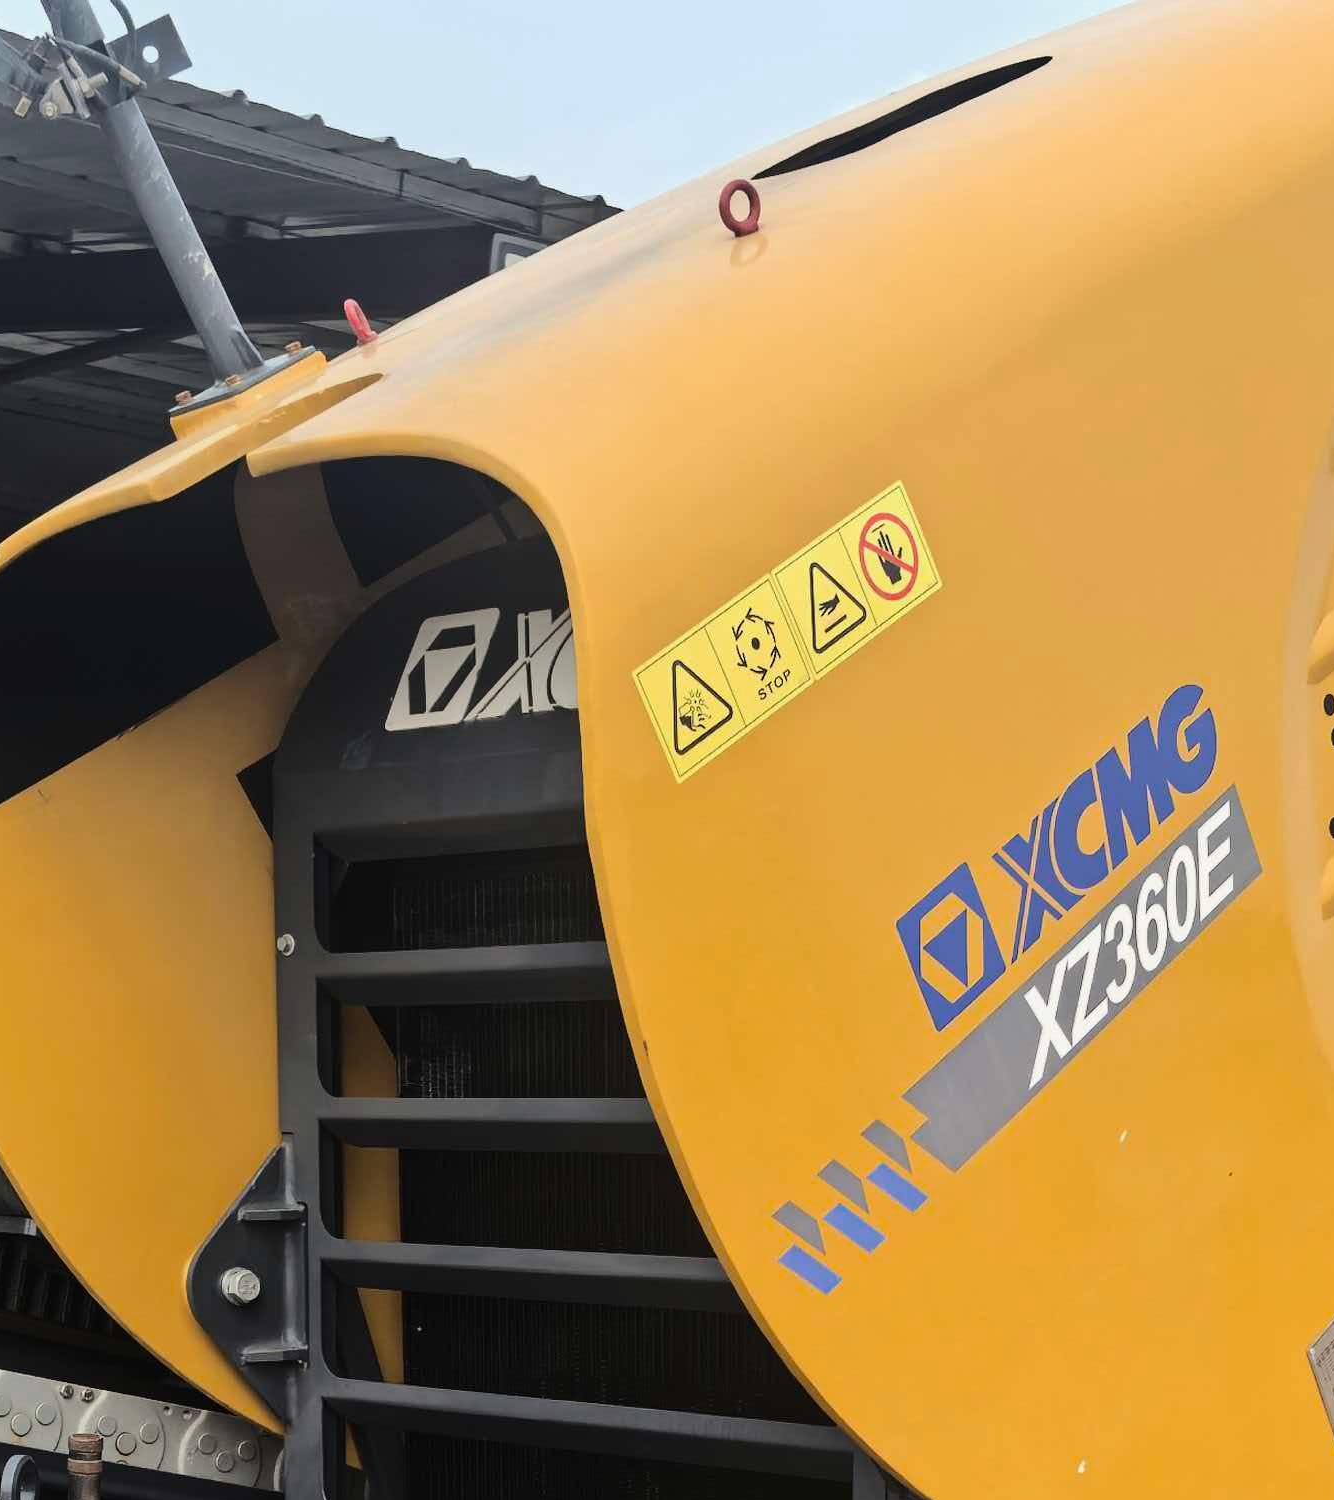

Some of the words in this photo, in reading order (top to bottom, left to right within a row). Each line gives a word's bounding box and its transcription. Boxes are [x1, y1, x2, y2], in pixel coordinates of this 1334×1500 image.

[757, 668, 791, 700] STOP
[992, 684, 1217, 964] XCMG
[1023, 799, 1234, 1090] XZ360E
